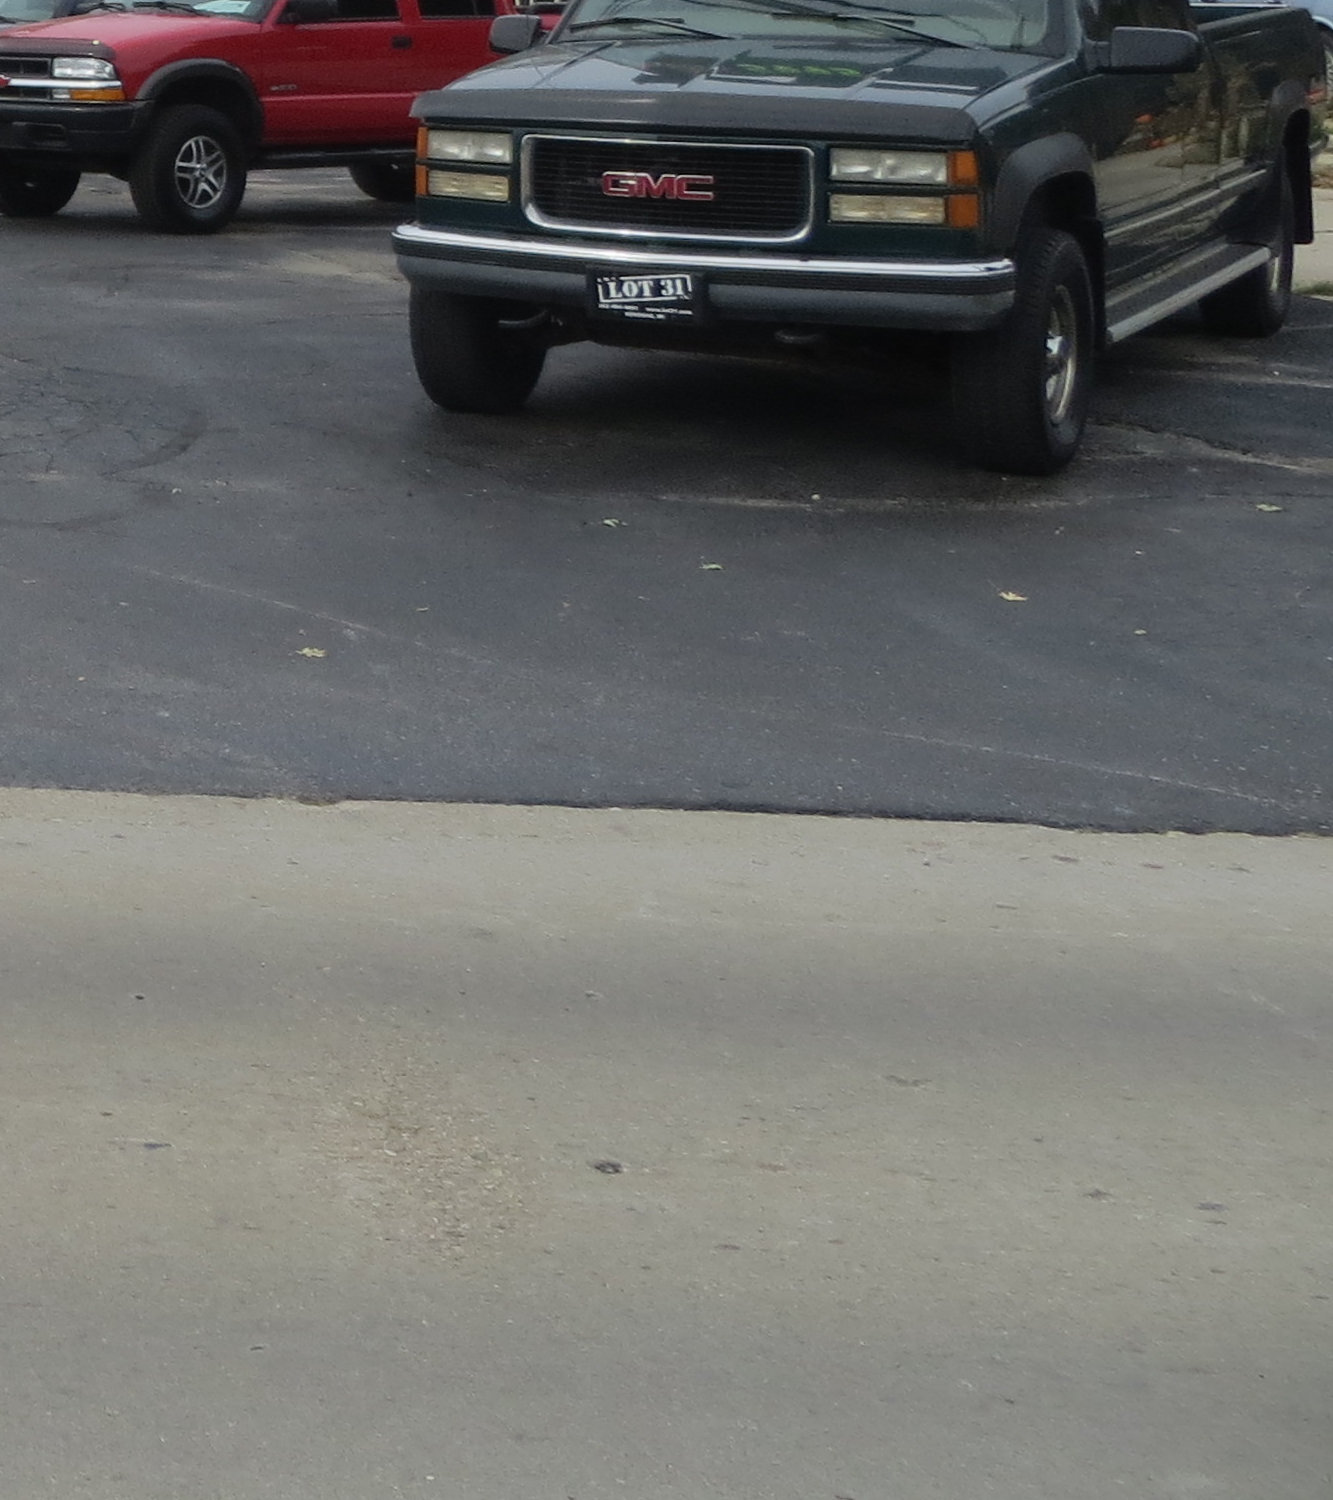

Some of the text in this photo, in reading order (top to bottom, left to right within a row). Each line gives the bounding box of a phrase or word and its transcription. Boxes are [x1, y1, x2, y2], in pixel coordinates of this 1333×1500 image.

[602, 171, 714, 201] GMC
[607, 279, 685, 298] LOT 31
